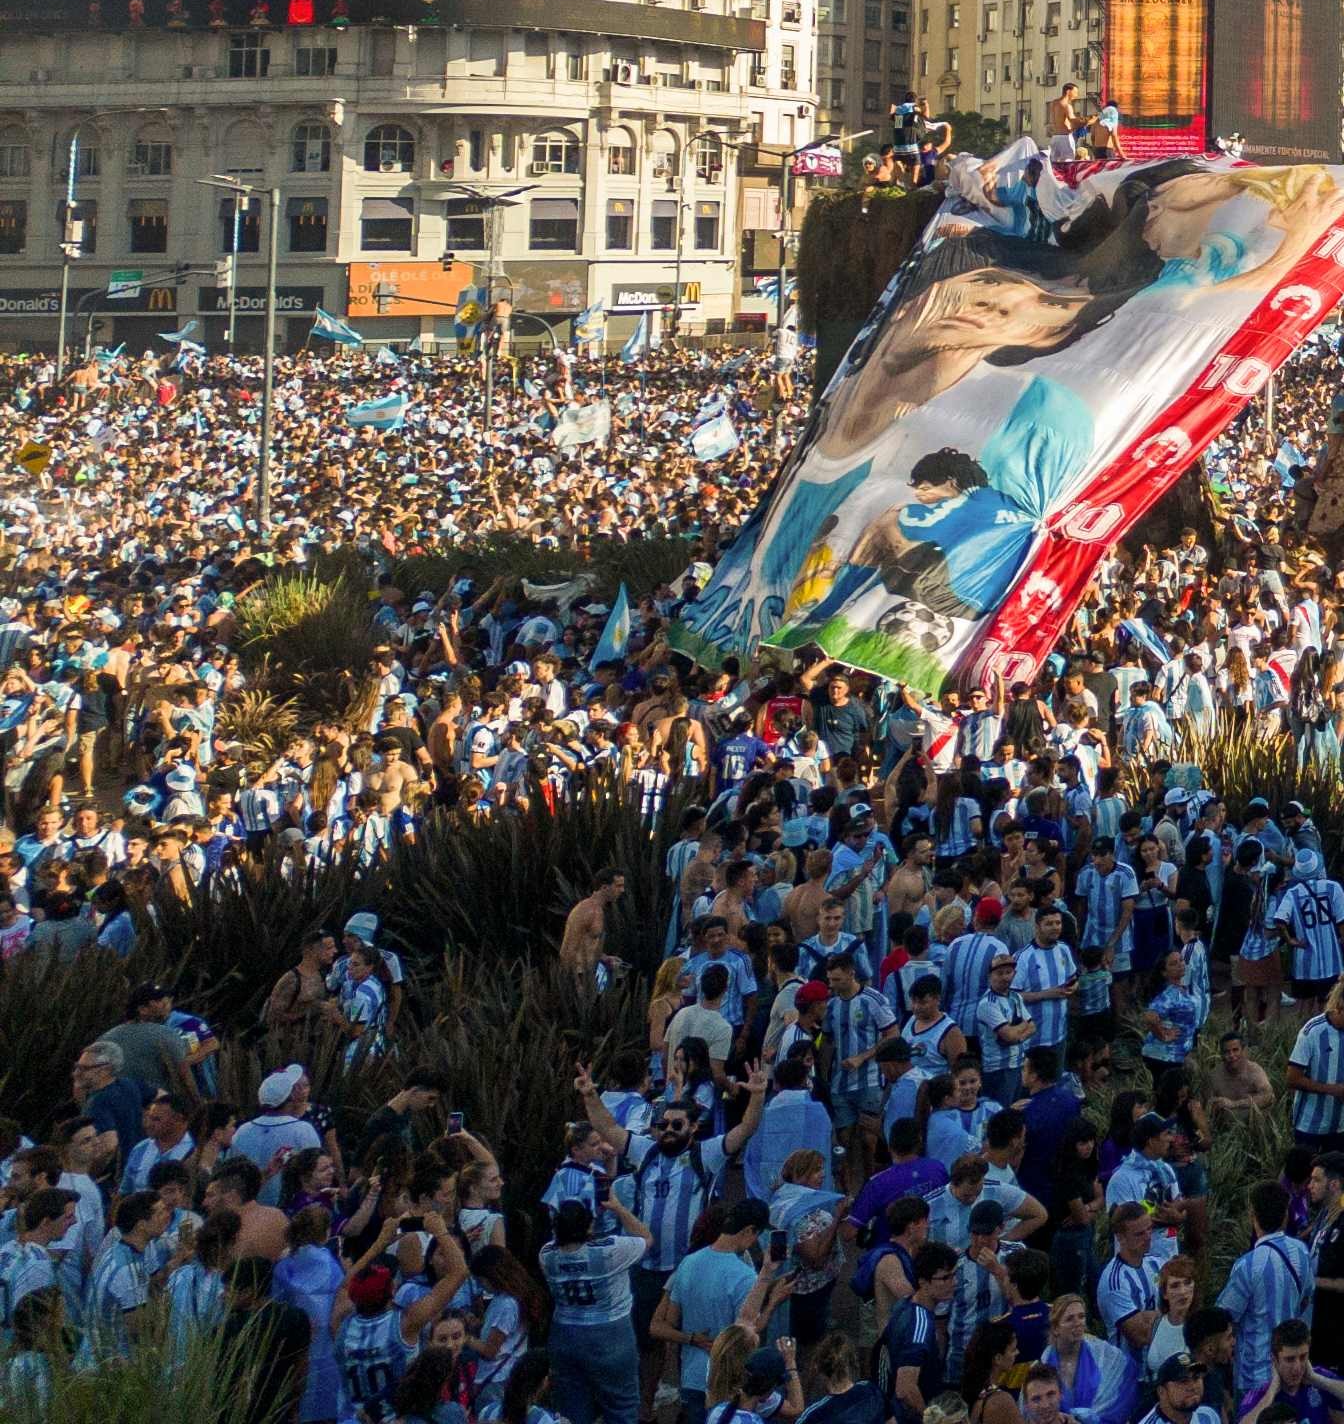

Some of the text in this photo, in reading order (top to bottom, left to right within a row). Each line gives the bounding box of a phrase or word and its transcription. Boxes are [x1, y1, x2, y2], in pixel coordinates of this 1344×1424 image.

[1199, 353, 1272, 396] 10
[1048, 500, 1125, 544] 10
[971, 636, 1037, 688] 10
